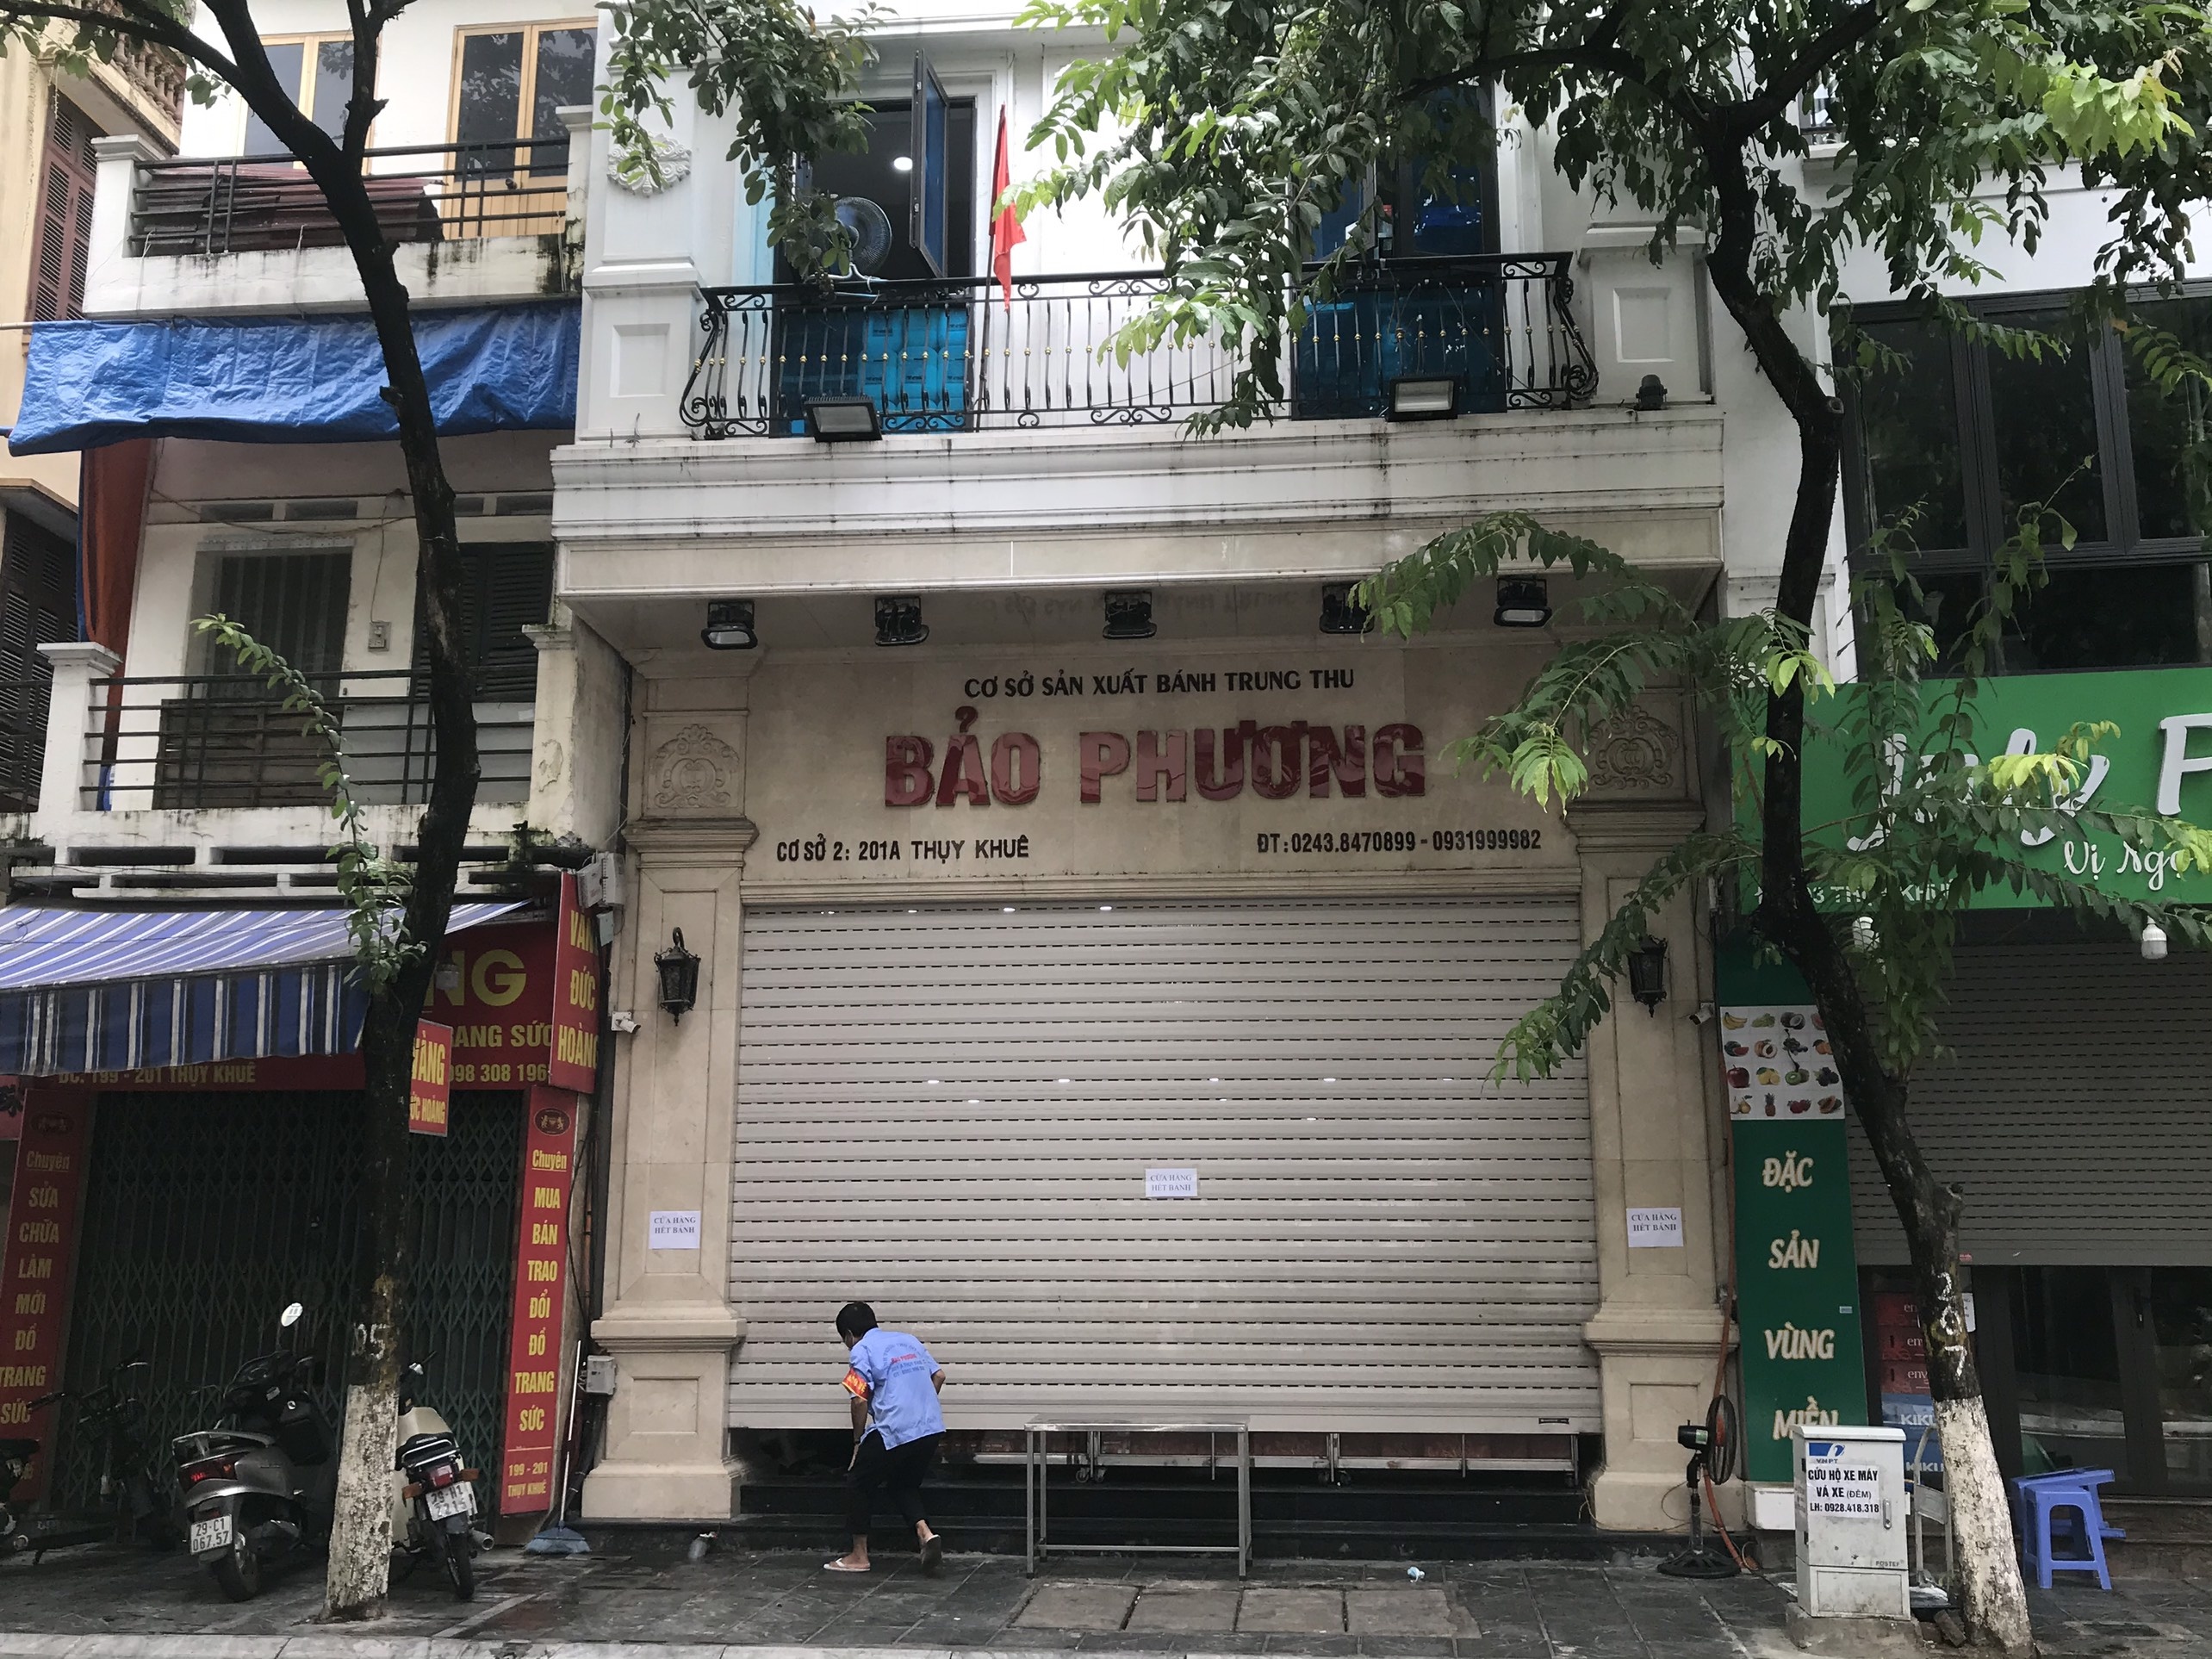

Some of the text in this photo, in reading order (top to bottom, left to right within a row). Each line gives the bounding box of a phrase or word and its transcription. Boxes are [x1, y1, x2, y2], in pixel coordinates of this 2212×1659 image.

[965, 668, 1355, 698] CƠ SỞ SẢN XUẤT BÁNH TRUNG THU
[885, 705, 1426, 807] BẢO PHƯƠNG
[777, 833, 1029, 864] CƠ SỞ 2: 201A THỤY KHUÊ
[1432, 830, 1541, 851] 0931999982
[570, 965, 595, 1011] ĐỨC
[510, 1020, 552, 1047] SỨC
[557, 1022, 599, 1070] HOÀNG
[134, 1067, 162, 1084] 201
[170, 1065, 208, 1087] THỤY
[214, 1061, 256, 1084] KHUÊ
[481, 1064, 511, 1082] 308
[517, 1063, 550, 1082] 196
[421, 1095, 446, 1124] HOÀNG
[27, 1151, 71, 1171] Chuyên
[532, 1148, 567, 1171] Chuyên
[1762, 1150, 1814, 1193] ĐẶC
[28, 1180, 59, 1208] SỬA
[534, 1187, 561, 1209] MUA
[19, 1220, 59, 1244] CHỮA
[531, 1219, 558, 1246] BÁN
[1768, 1228, 1820, 1269] SẢN
[18, 1256, 53, 1279] LÀM
[527, 1259, 558, 1282] TRAO
[15, 1289, 47, 1314] MỚI
[529, 1288, 551, 1319] ĐỔI
[1764, 1321, 1836, 1359] VÙNG
[0, 1365, 47, 1387] TRANG
[514, 1370, 555, 1394] TRANG
[1, 1397, 31, 1424] SỨC
[519, 1404, 545, 1432] SỨC
[508, 1463, 525, 1477] 199
[532, 1461, 549, 1476] 201
[1808, 1467, 1878, 1482] CỨU HỘ XE MÁY
[507, 1480, 546, 1499] THỤY KHUÊ
[1816, 1484, 1872, 1500] VÁ XE (ĐÊM)
[1810, 1502, 1880, 1513] LH: 0928.418.318
[196, 1518, 225, 1537] 29-C1
[192, 1531, 229, 1551] 067.57
